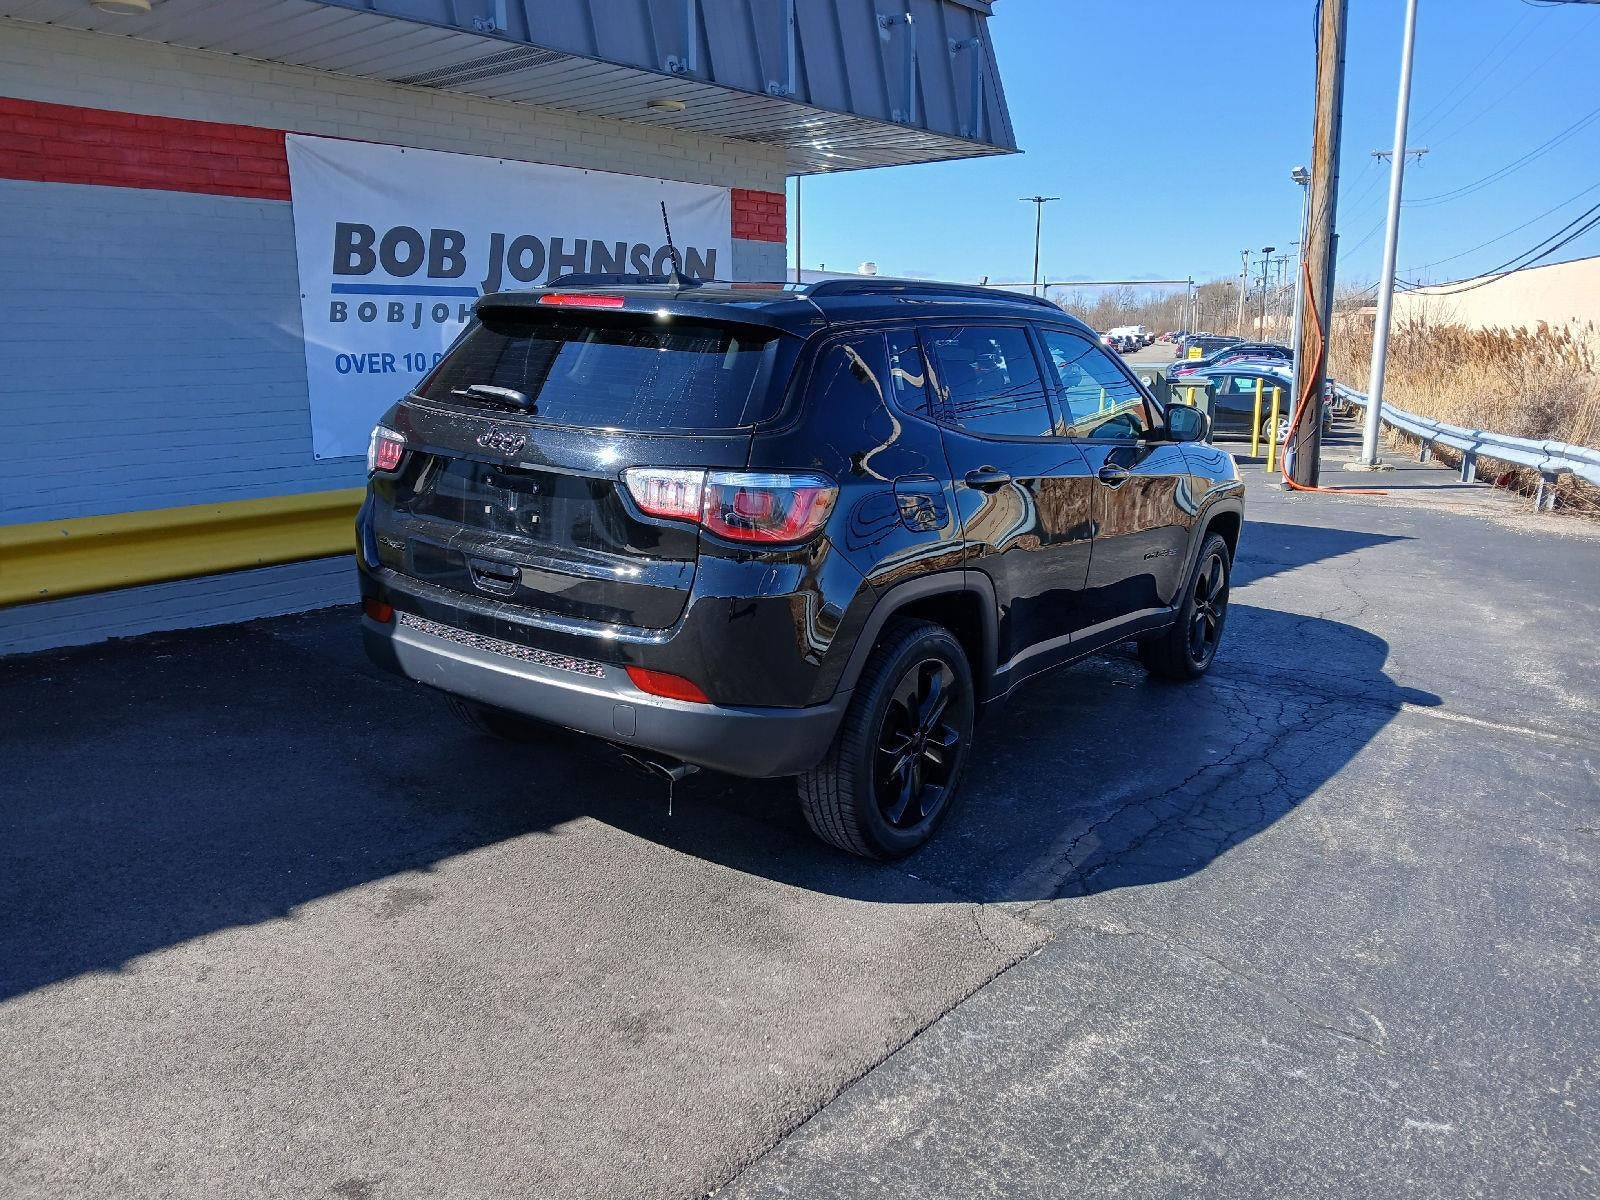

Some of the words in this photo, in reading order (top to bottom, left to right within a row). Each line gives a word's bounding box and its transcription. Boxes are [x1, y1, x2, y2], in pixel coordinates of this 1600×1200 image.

[333, 222, 467, 278] BOB
[481, 233, 717, 294] JOHNSON
[335, 352, 397, 374] OVER
[477, 426, 527, 456] Jeep
